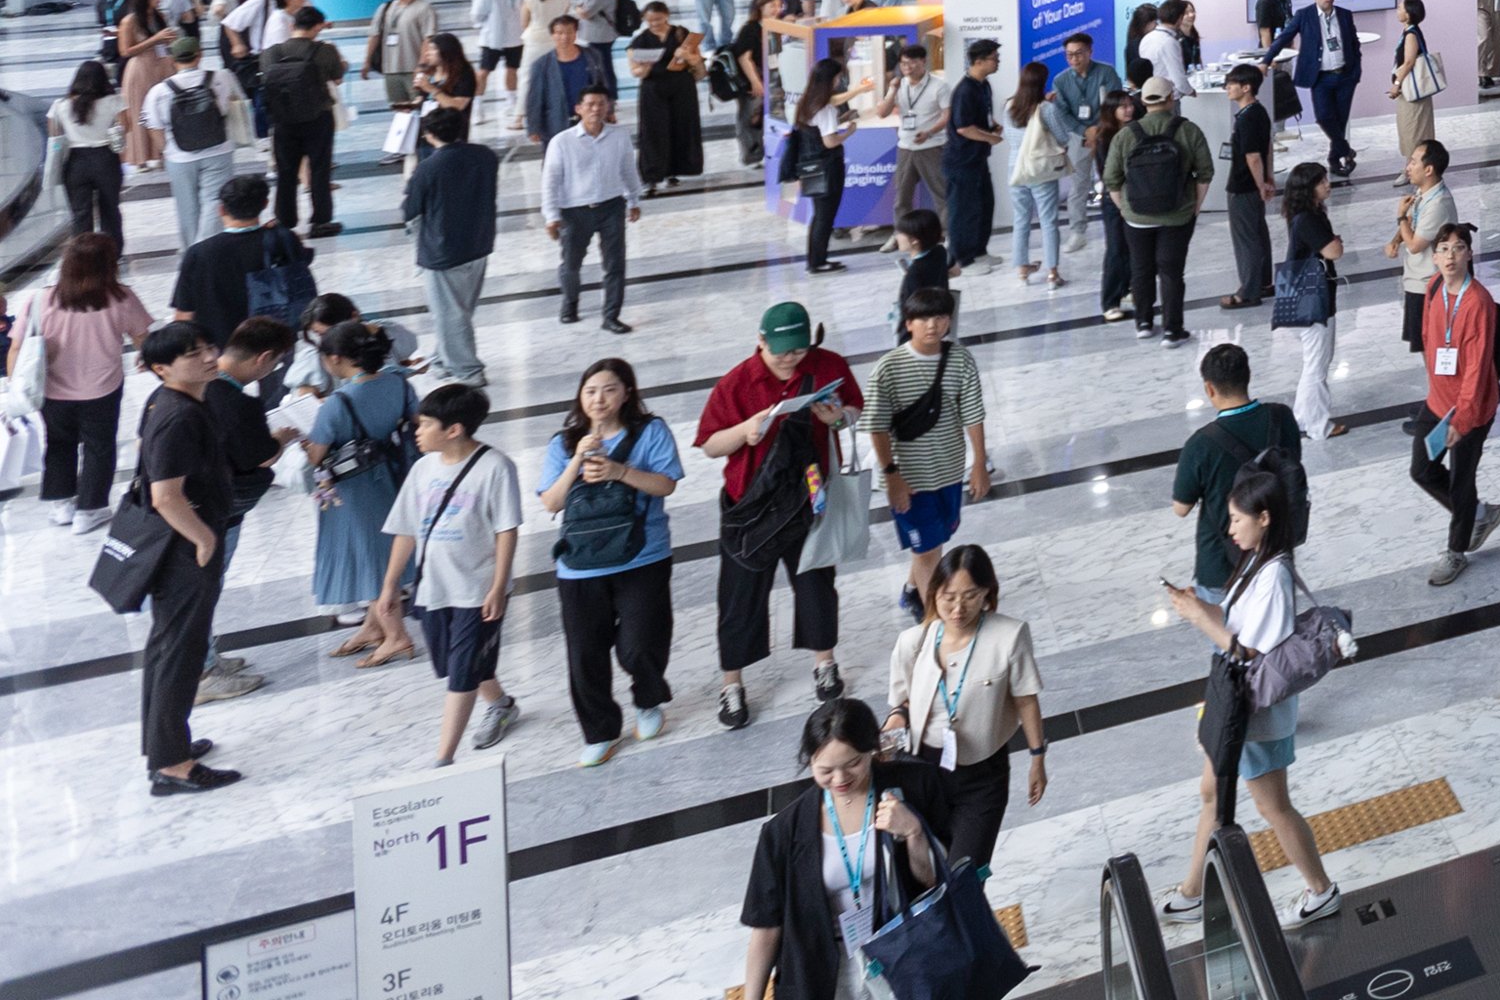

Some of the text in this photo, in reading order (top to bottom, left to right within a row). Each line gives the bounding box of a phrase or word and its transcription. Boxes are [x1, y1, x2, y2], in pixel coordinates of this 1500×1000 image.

[1032, 1, 1086, 30] of Your Data
[847, 163, 897, 175] Absolute
[844, 175, 888, 188] gaging.
[372, 796, 444, 820] Escalator
[373, 814, 490, 871] North 1F
[380, 902, 410, 925] 4F
[382, 908, 482, 943] 오디토리움 미팅룸
[259, 930, 305, 949] 주의안내
[383, 968, 412, 992] 3F
